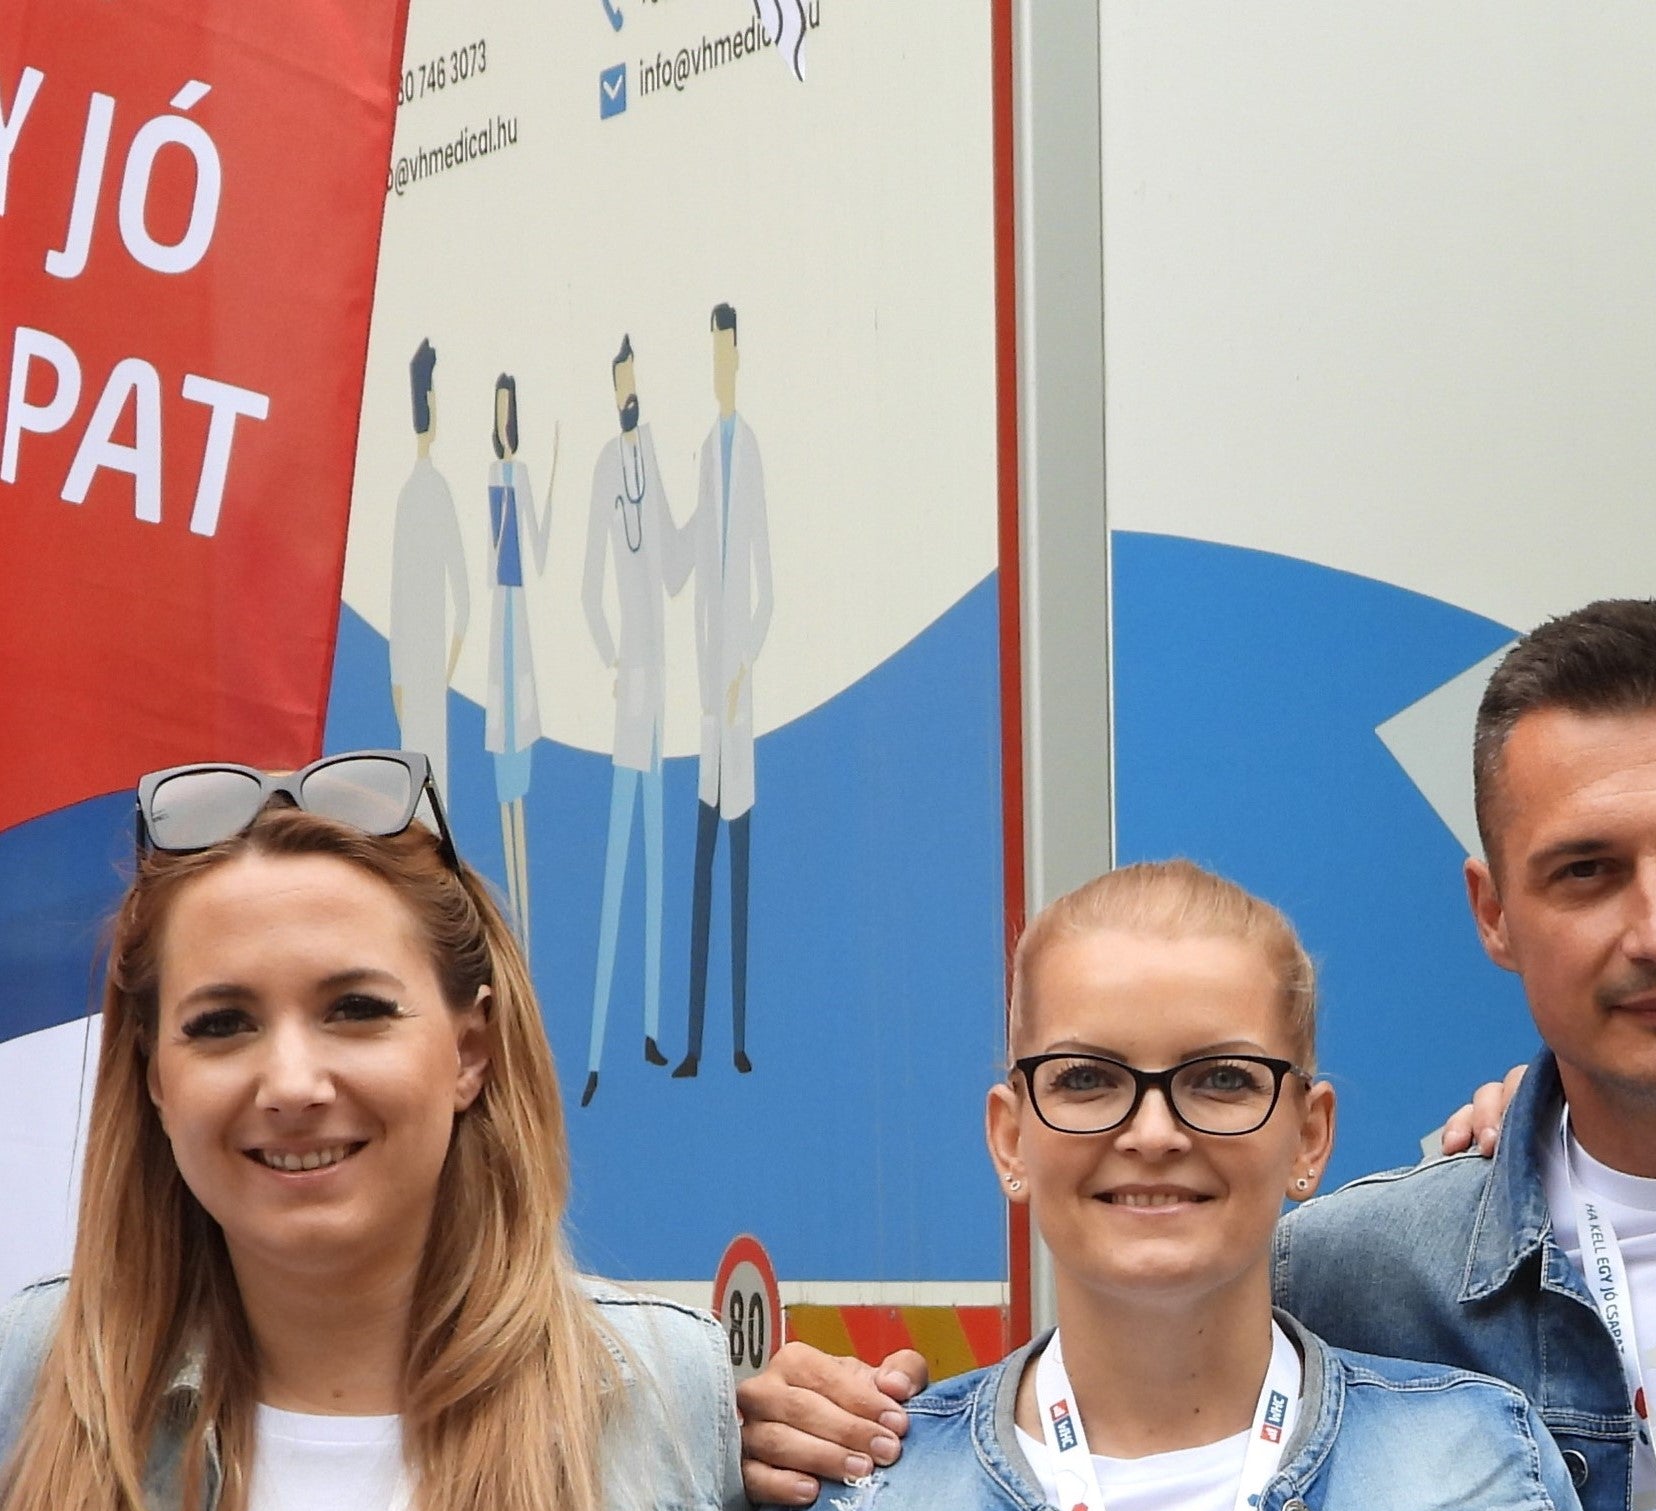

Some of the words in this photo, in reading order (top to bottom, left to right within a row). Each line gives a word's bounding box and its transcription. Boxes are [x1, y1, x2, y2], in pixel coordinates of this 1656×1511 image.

[640, 1, 820, 96] info@vhmedicu
[418, 56, 446, 98] 746
[450, 39, 487, 84] 3073
[45, 79, 222, 279] JÓ
[0, 326, 270, 537] PAT
[1585, 1203, 1599, 1221] HA
[1590, 1223, 1606, 1254] KELL
[1597, 1257, 1613, 1283] EGY
[1600, 1286, 1618, 1302] JÓ
[729, 1290, 764, 1369] 80
[1267, 1395, 1285, 1422] WHC
[1057, 1422, 1074, 1447] WHC
